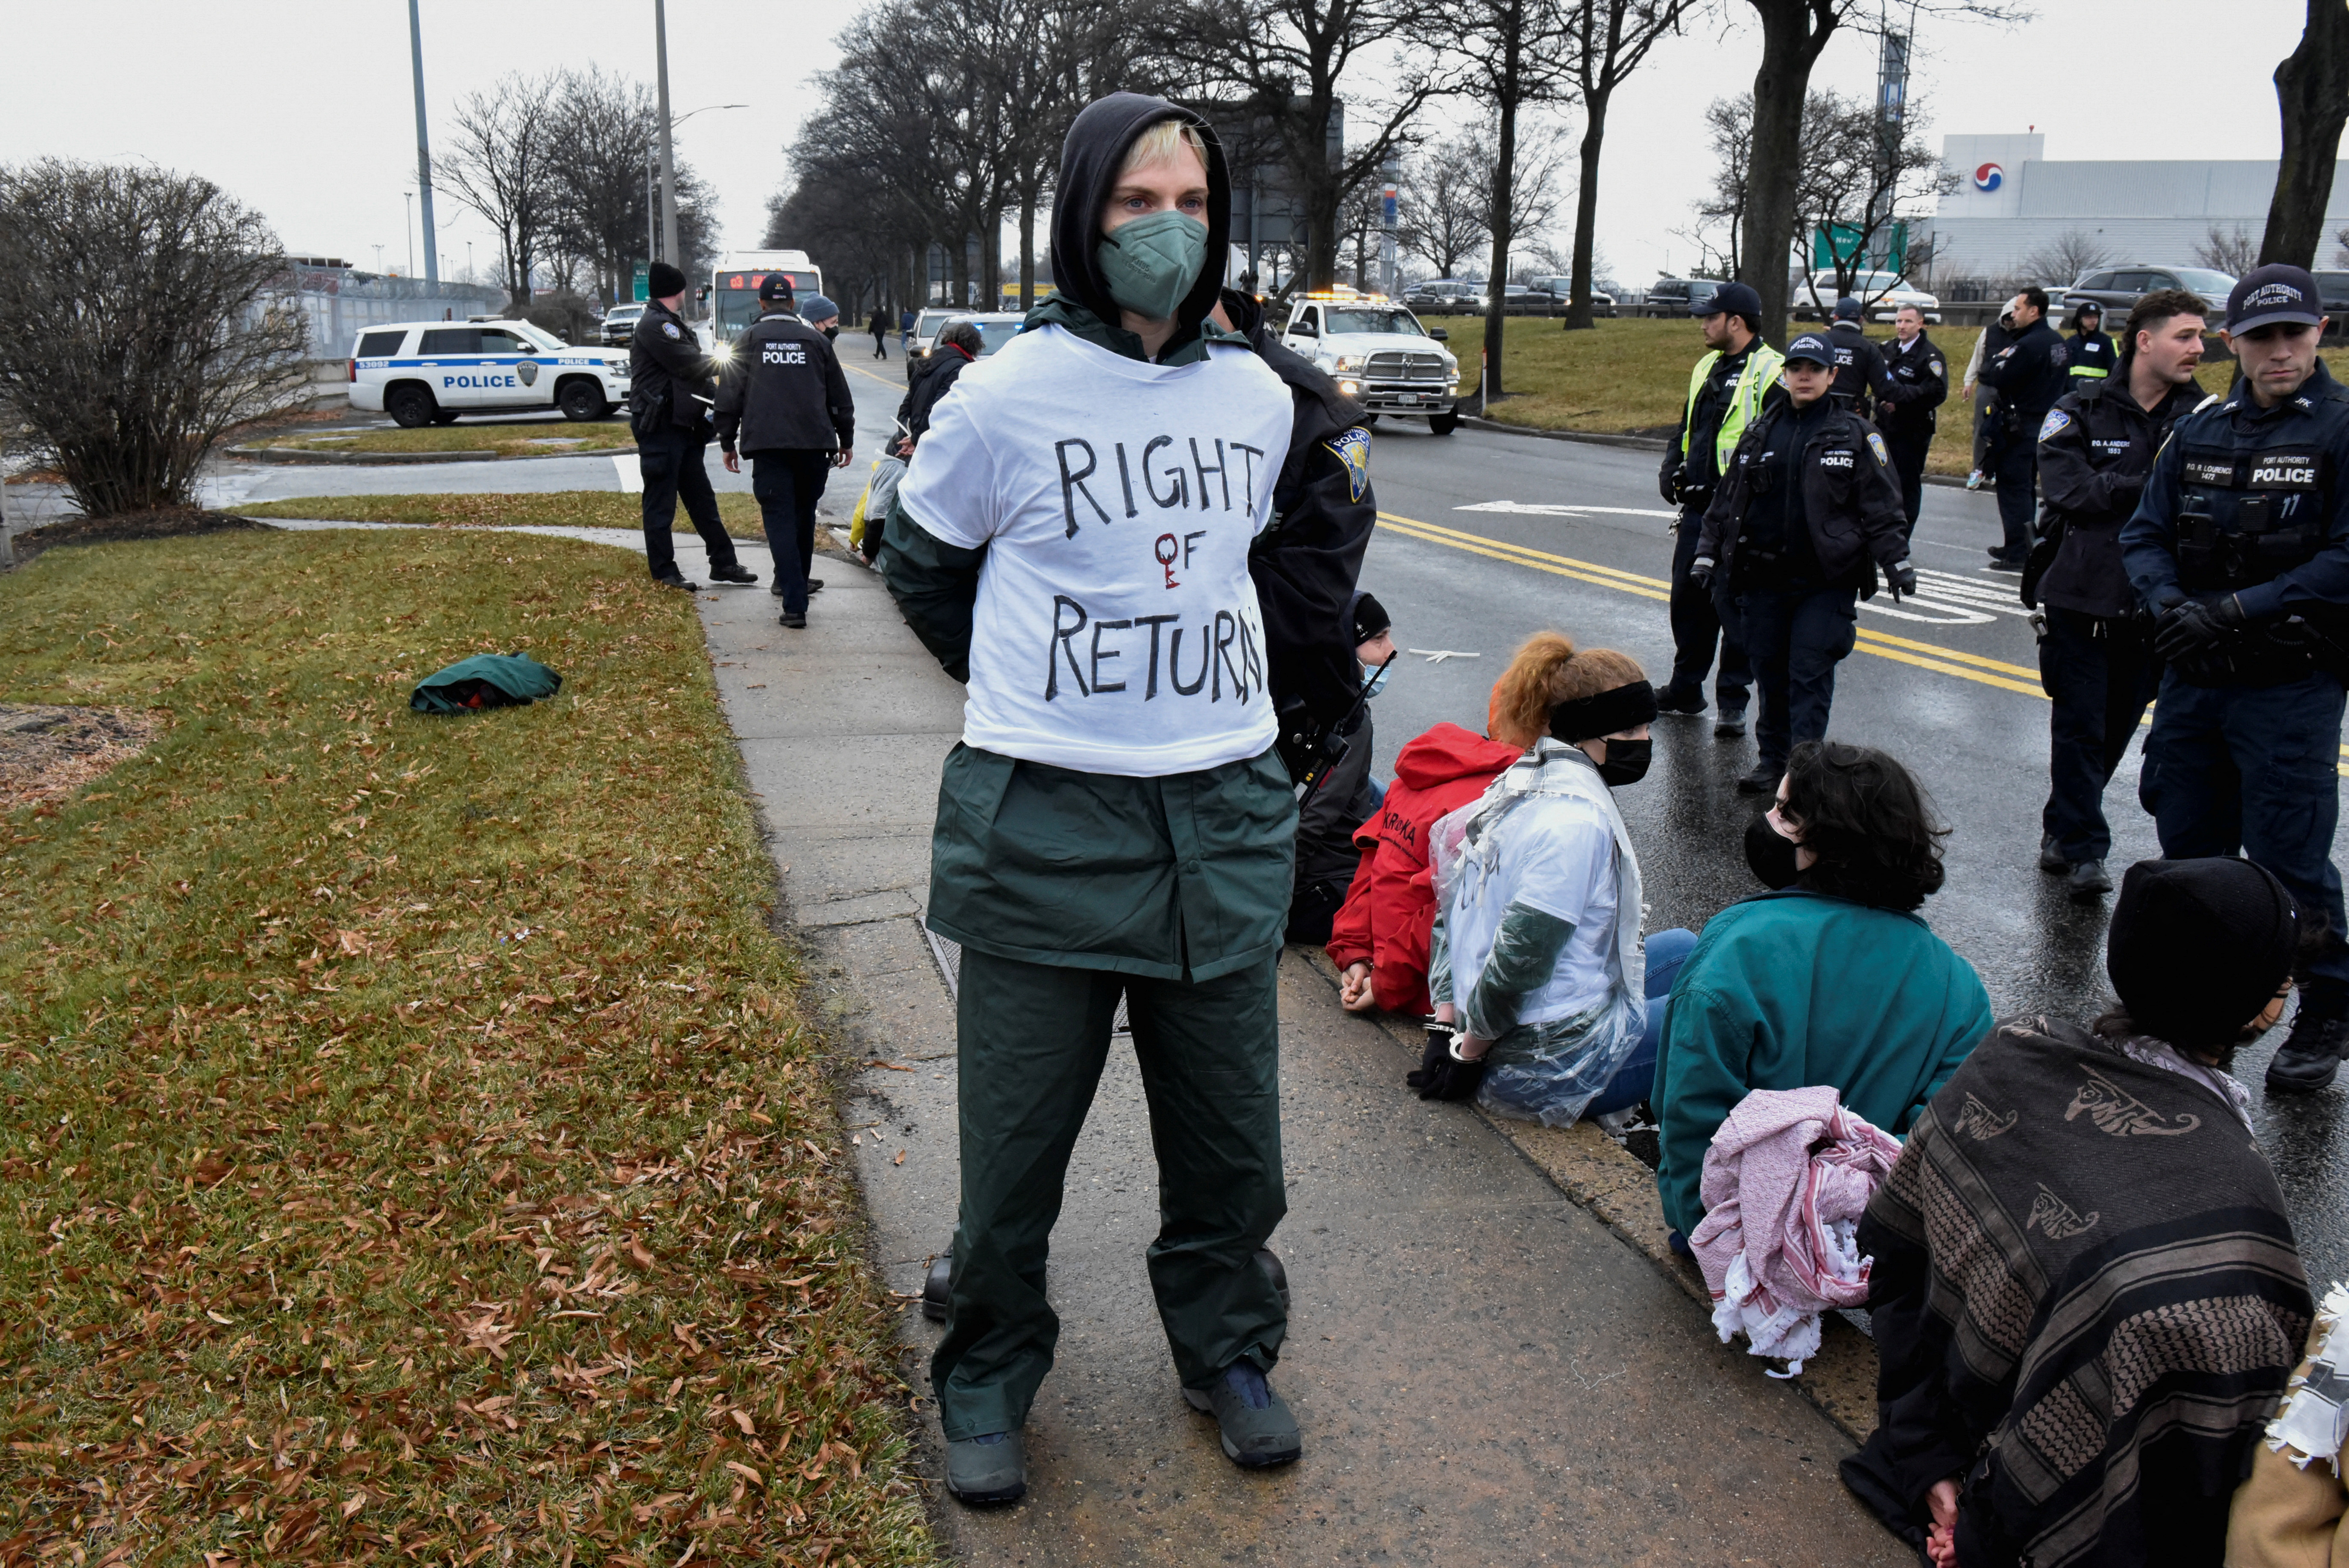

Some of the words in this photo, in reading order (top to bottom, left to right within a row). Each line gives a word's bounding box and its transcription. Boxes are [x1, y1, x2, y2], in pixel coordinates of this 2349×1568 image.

[2243, 289, 2260, 310] PORT
[2260, 284, 2302, 302] AUTHORITY
[2257, 296, 2288, 307] POLICE
[1790, 340, 1800, 352] PORT
[1800, 337, 1824, 351] AUTHORITY
[763, 352, 805, 364] POLICE
[1835, 354, 1853, 365] LICE
[1898, 369, 1916, 378] POLICE
[444, 375, 515, 388] POLICE
[2223, 401, 2238, 410] JFK
[2295, 397, 2313, 407] JFK
[1340, 451, 1352, 464] NEW
[1821, 457, 1854, 468] POLICE
[2277, 456, 2310, 464] AUTHORITY
[2204, 466, 2232, 474] LOURENCO
[2252, 468, 2315, 483] POLICE
[1055, 435, 1265, 540] RIGHT
[1155, 530, 1207, 571] OF
[1046, 595, 1262, 706] RETURN
[1382, 812, 1416, 846] KROKA
